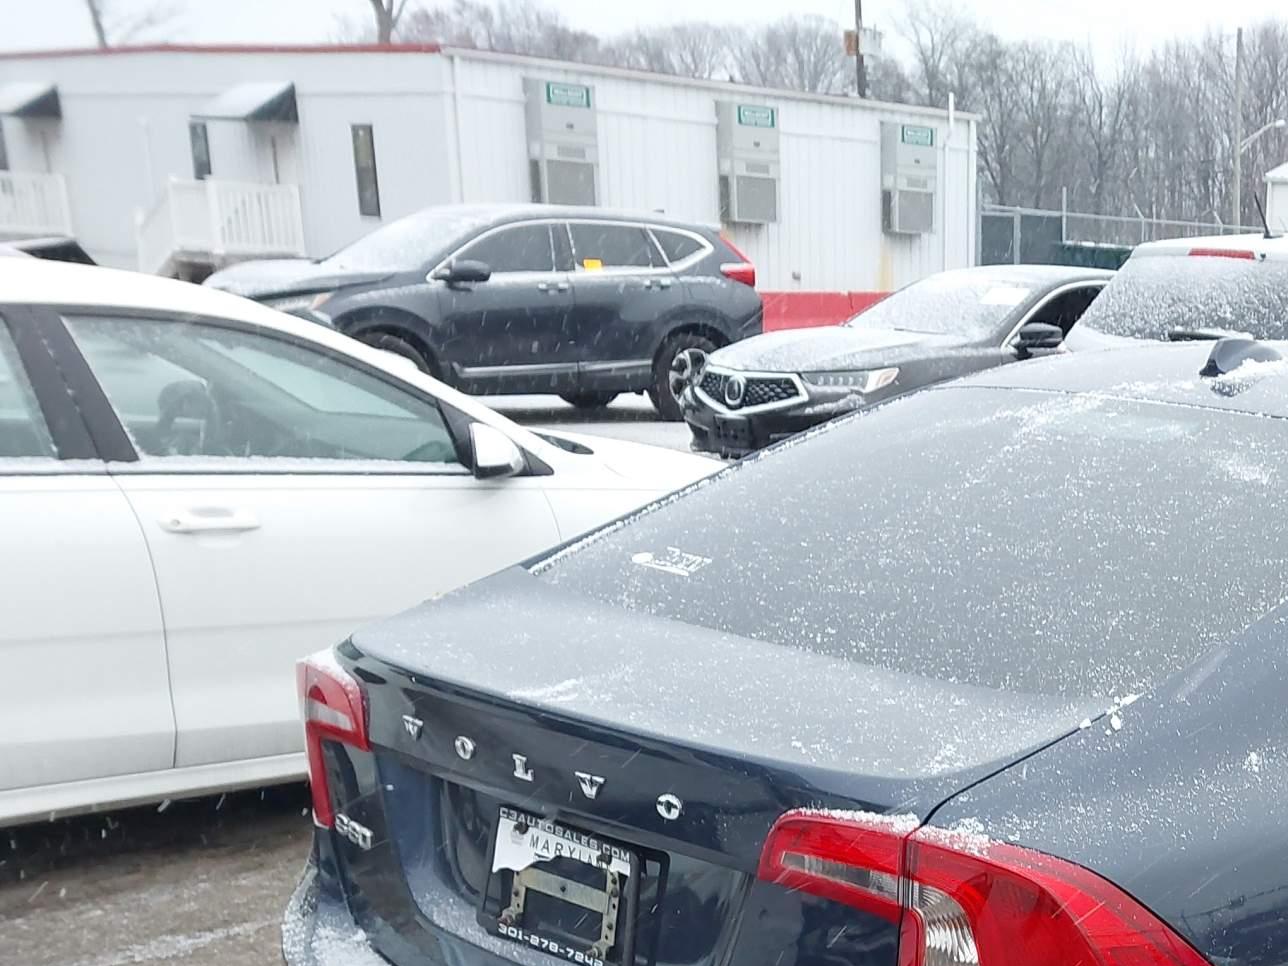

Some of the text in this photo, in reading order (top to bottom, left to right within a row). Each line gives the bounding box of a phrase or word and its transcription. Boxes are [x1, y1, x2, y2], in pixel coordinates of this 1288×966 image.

[402, 714, 683, 820] VOLVO
[335, 813, 373, 850] S60
[499, 806, 630, 862] C3AUTOSALES.COM
[529, 834, 608, 868] MARYLA
